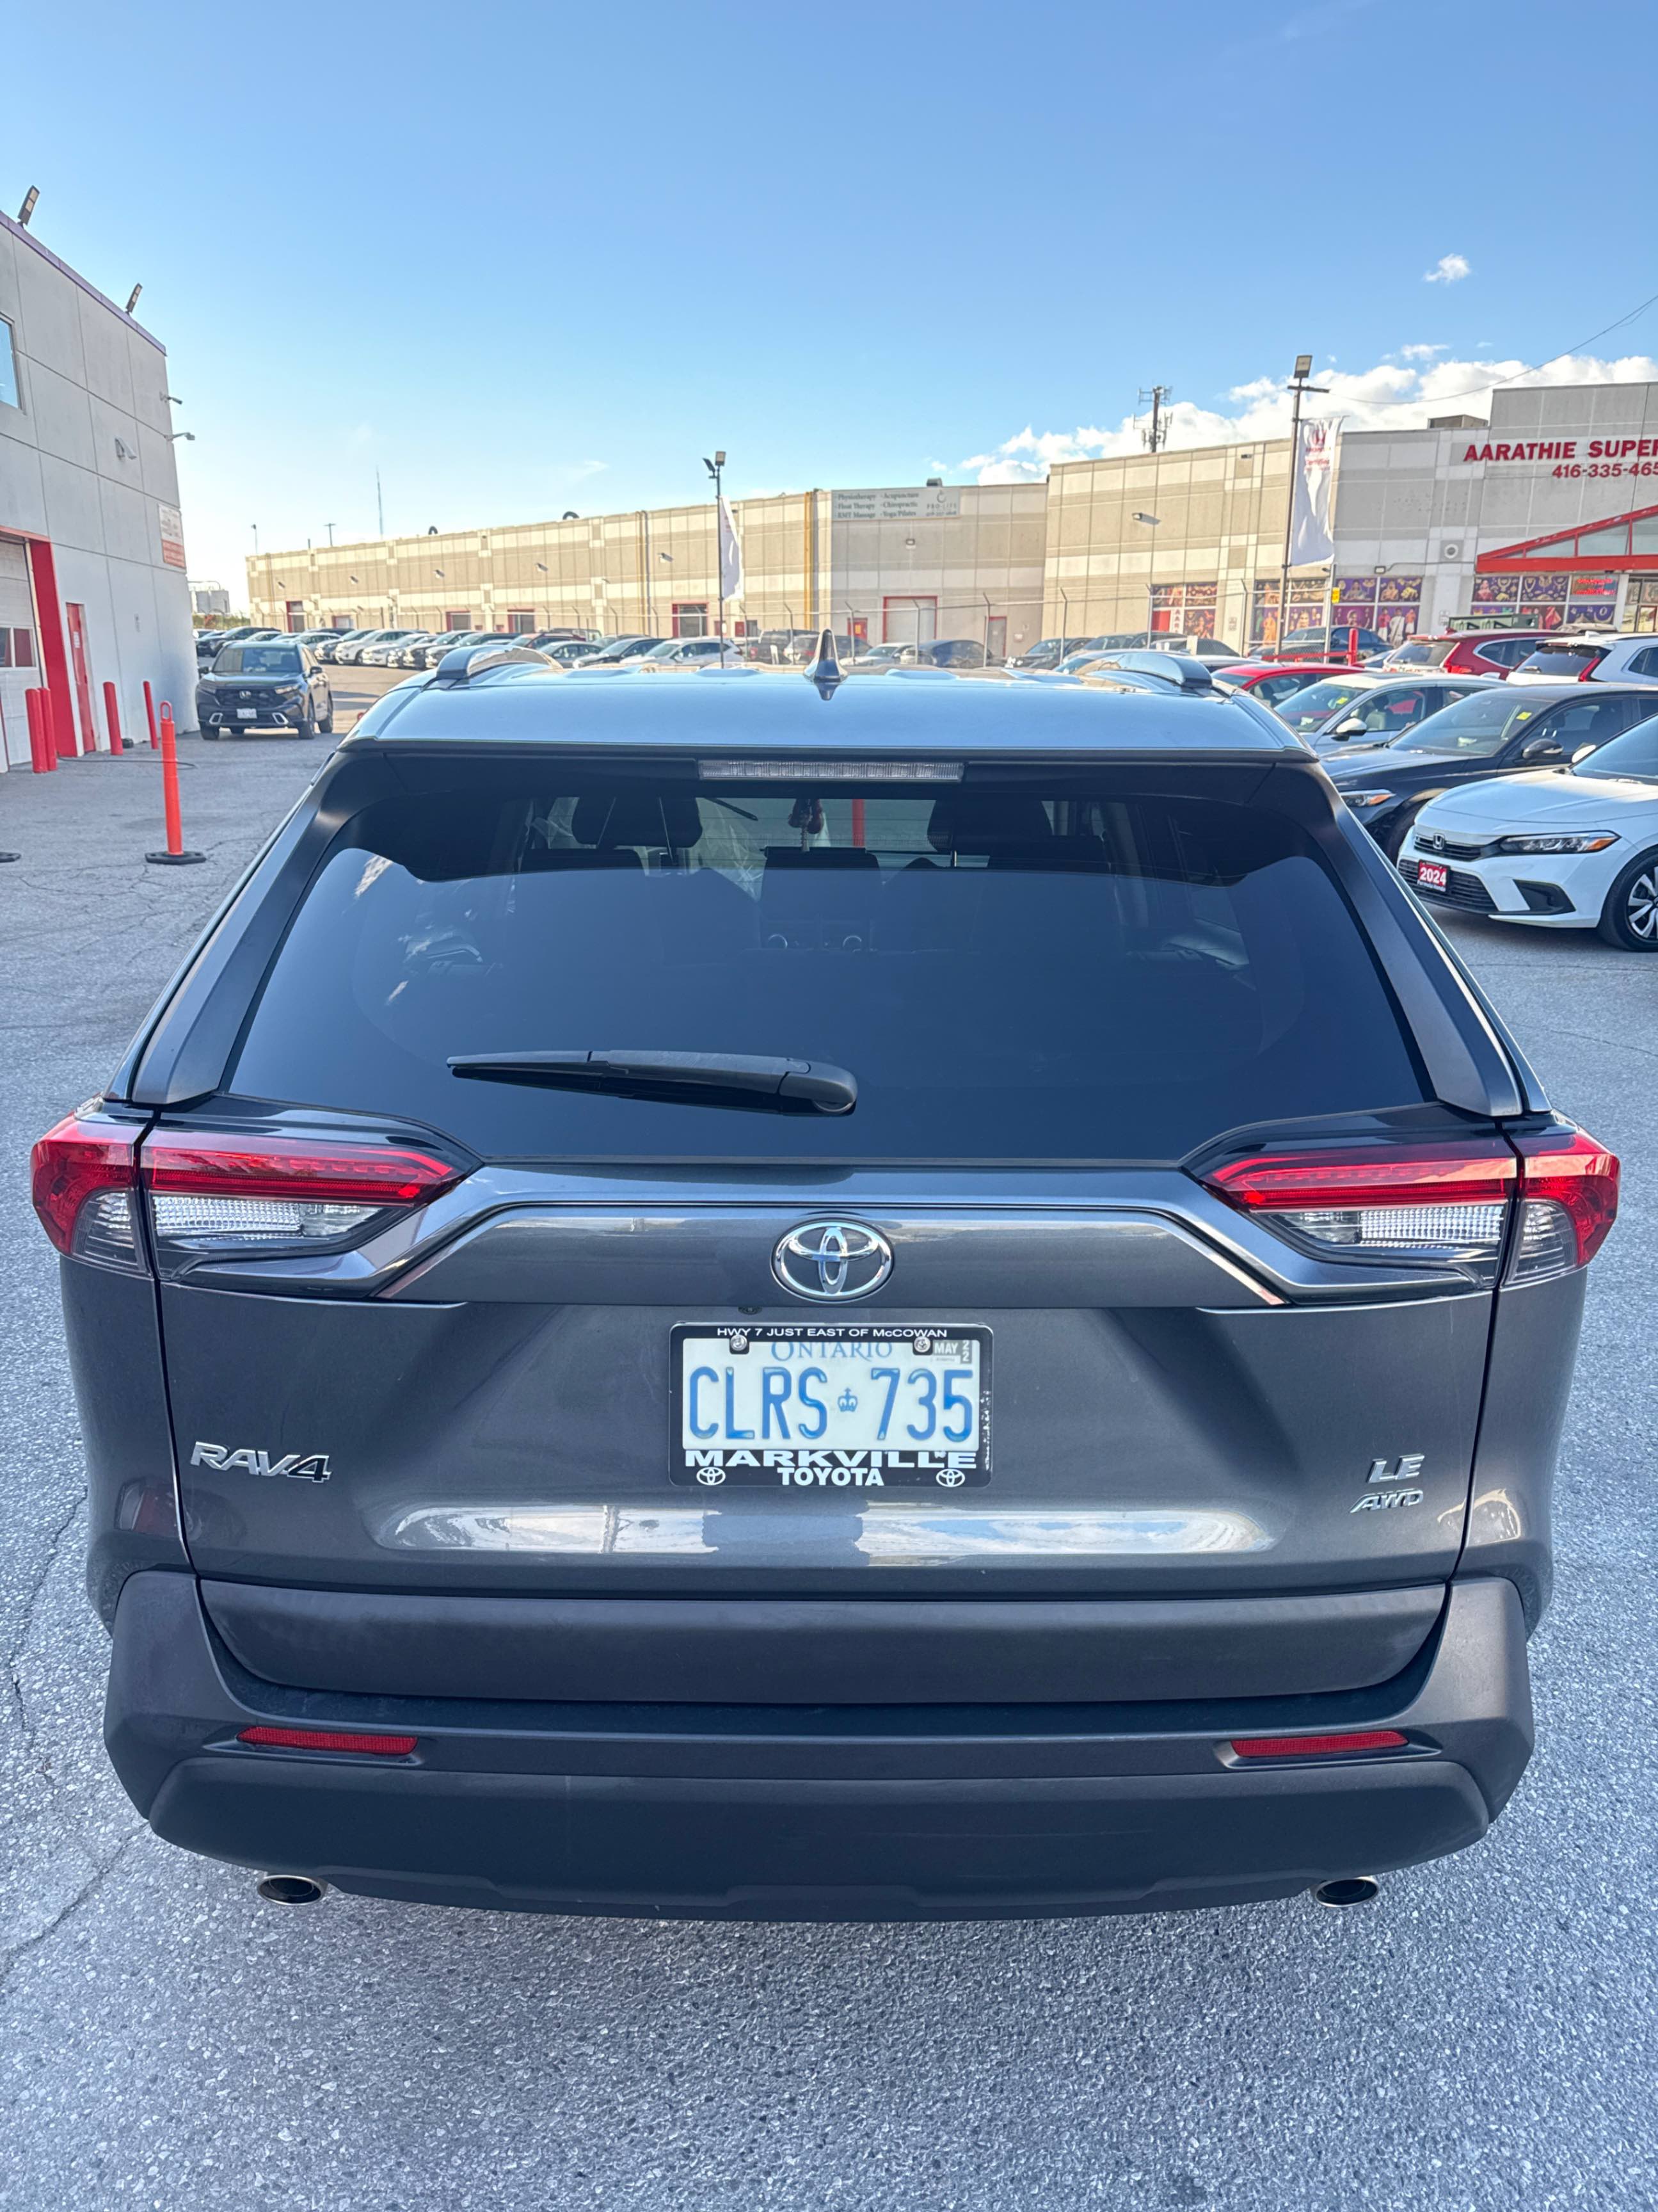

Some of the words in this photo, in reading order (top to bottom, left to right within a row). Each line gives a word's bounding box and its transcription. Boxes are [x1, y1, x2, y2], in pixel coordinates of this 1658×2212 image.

[1463, 442, 1577, 462] AARATHIE
[853, 502, 875, 511] Therapy
[883, 501, 918, 509] Chiropractic
[1419, 867, 1446, 886] 2024
[717, 1328, 751, 1336] HWY
[755, 1328, 763, 1336] 7
[767, 1328, 803, 1337] JUST
[807, 1328, 845, 1337] EAST
[849, 1329, 869, 1337] OF
[873, 1329, 947, 1338] McCOWAN
[771, 1342, 893, 1361] ONTARIO
[934, 1342, 959, 1354] MAY
[689, 1366, 828, 1440] CLRS
[870, 1367, 973, 1443] 735
[190, 1441, 332, 1484] RAV4
[685, 1450, 977, 1469] MARKVILLE
[1366, 1453, 1425, 1484] LE
[776, 1467, 885, 1486] TOYOTA
[1349, 1488, 1424, 1514] AWD
